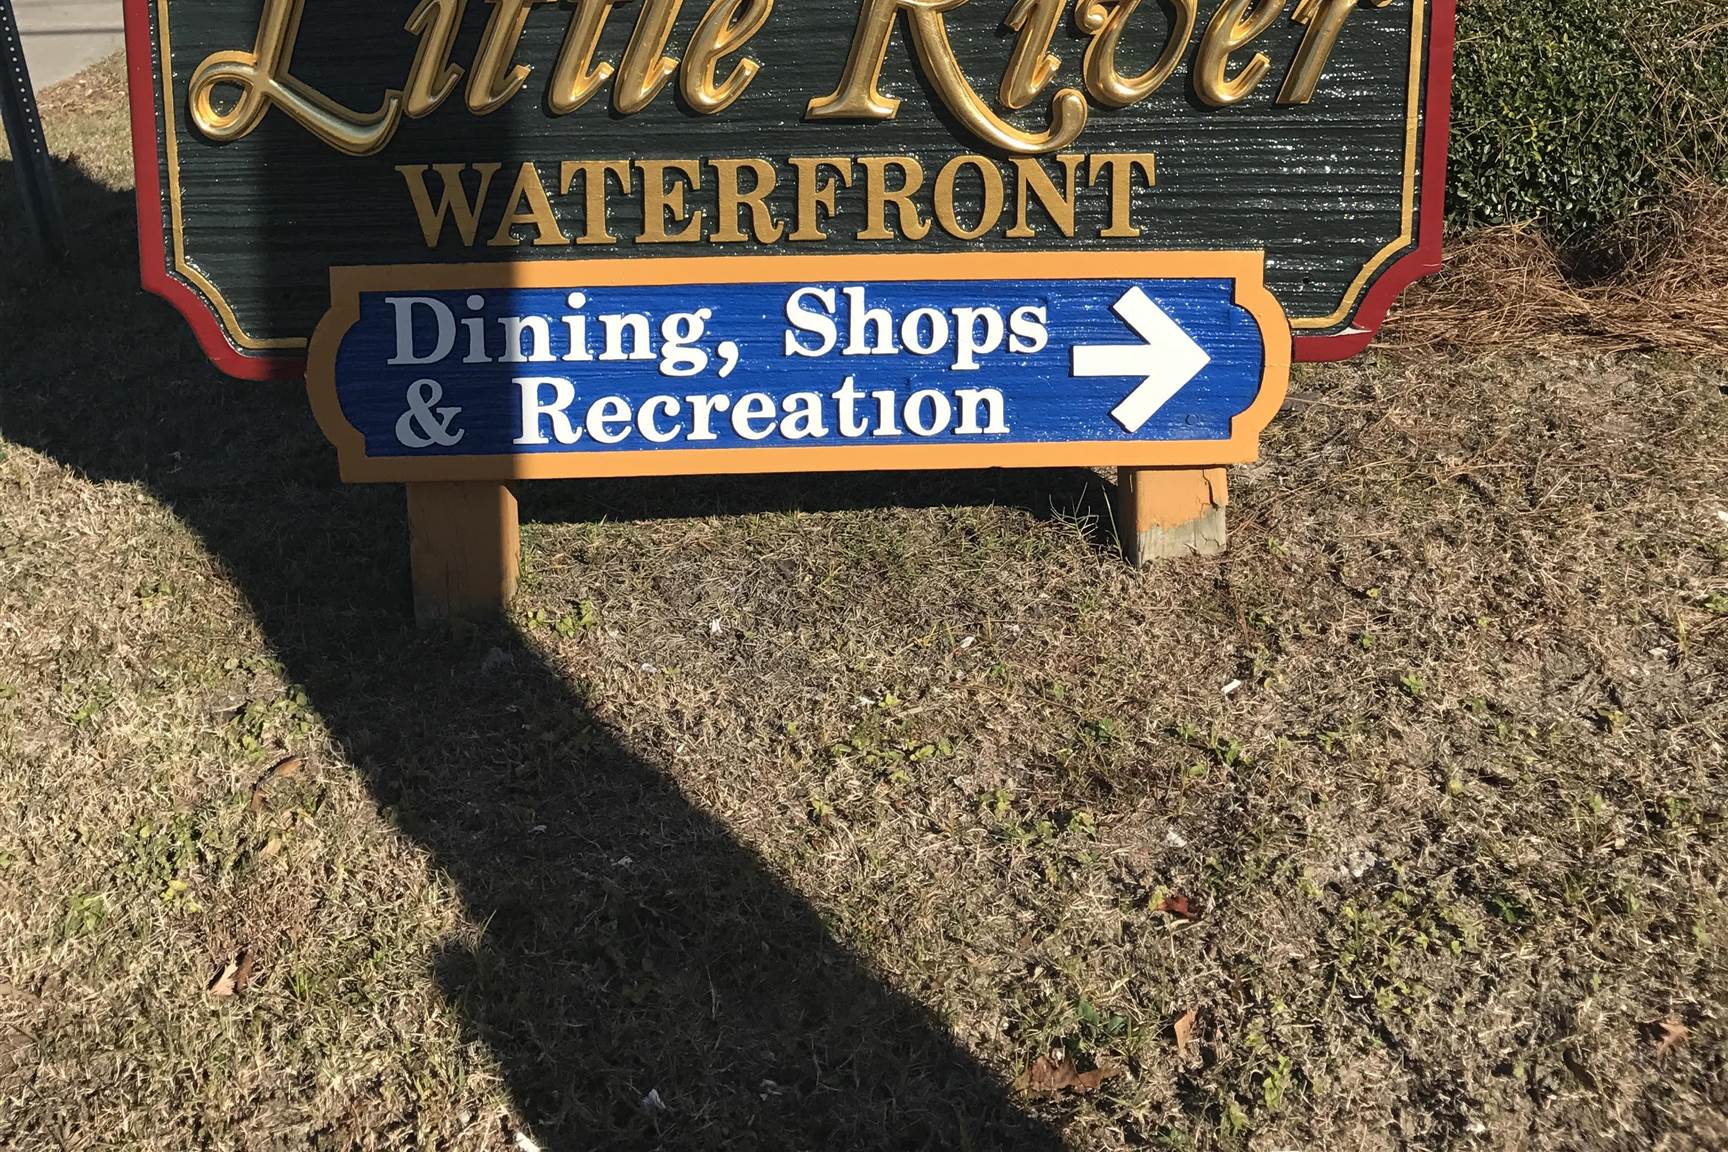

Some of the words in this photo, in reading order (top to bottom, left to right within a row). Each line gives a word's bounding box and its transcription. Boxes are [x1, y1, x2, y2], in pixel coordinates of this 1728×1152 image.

[395, 152, 1158, 249] WATERFRONT
[385, 290, 741, 379] Dining,
[784, 285, 1049, 374] Shops
[393, 378, 466, 449] &
[511, 374, 1009, 448] Recreation
